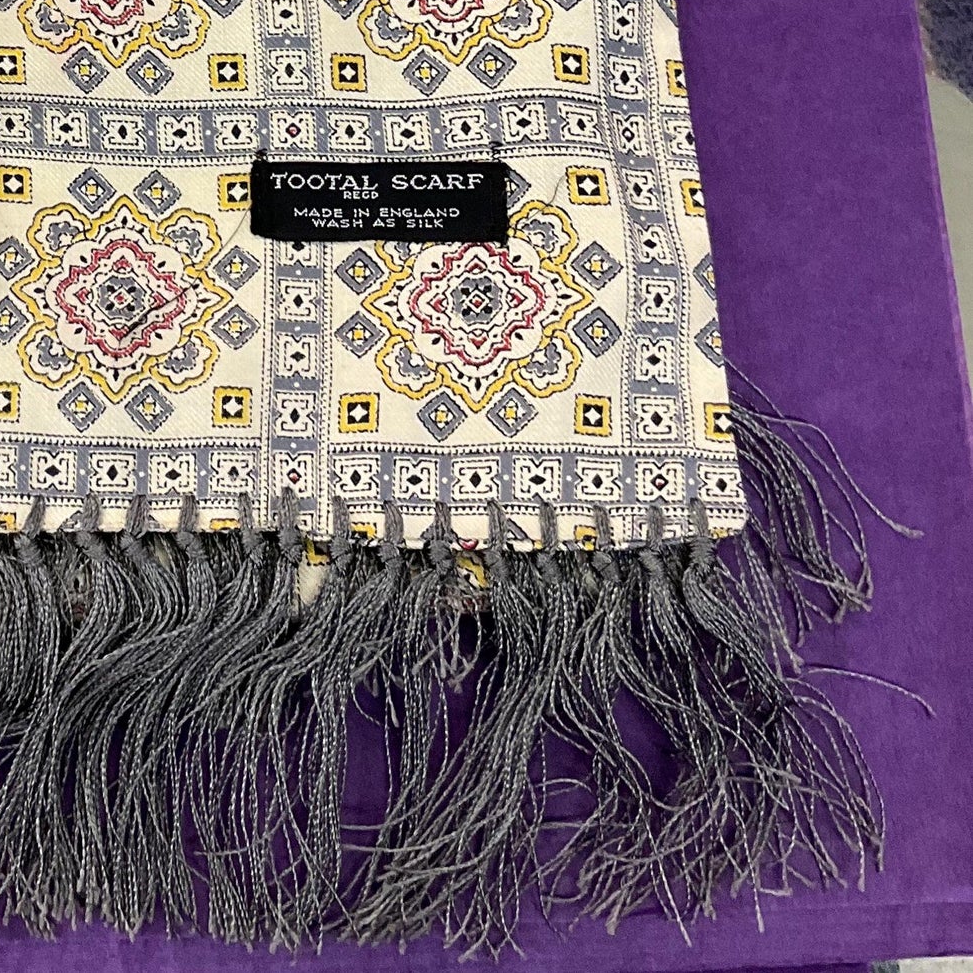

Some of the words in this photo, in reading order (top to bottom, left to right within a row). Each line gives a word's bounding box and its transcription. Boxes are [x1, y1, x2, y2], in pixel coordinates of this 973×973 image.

[270, 172, 378, 190] TOOTAL
[391, 173, 484, 190] SCARF
[343, 190, 379, 200] REGD
[293, 207, 343, 218] MADE
[354, 207, 370, 218] IN
[379, 207, 460, 218] ENGLAND
[312, 218, 363, 228] WASH
[372, 218, 395, 228] AS
[406, 218, 444, 228] SILK
